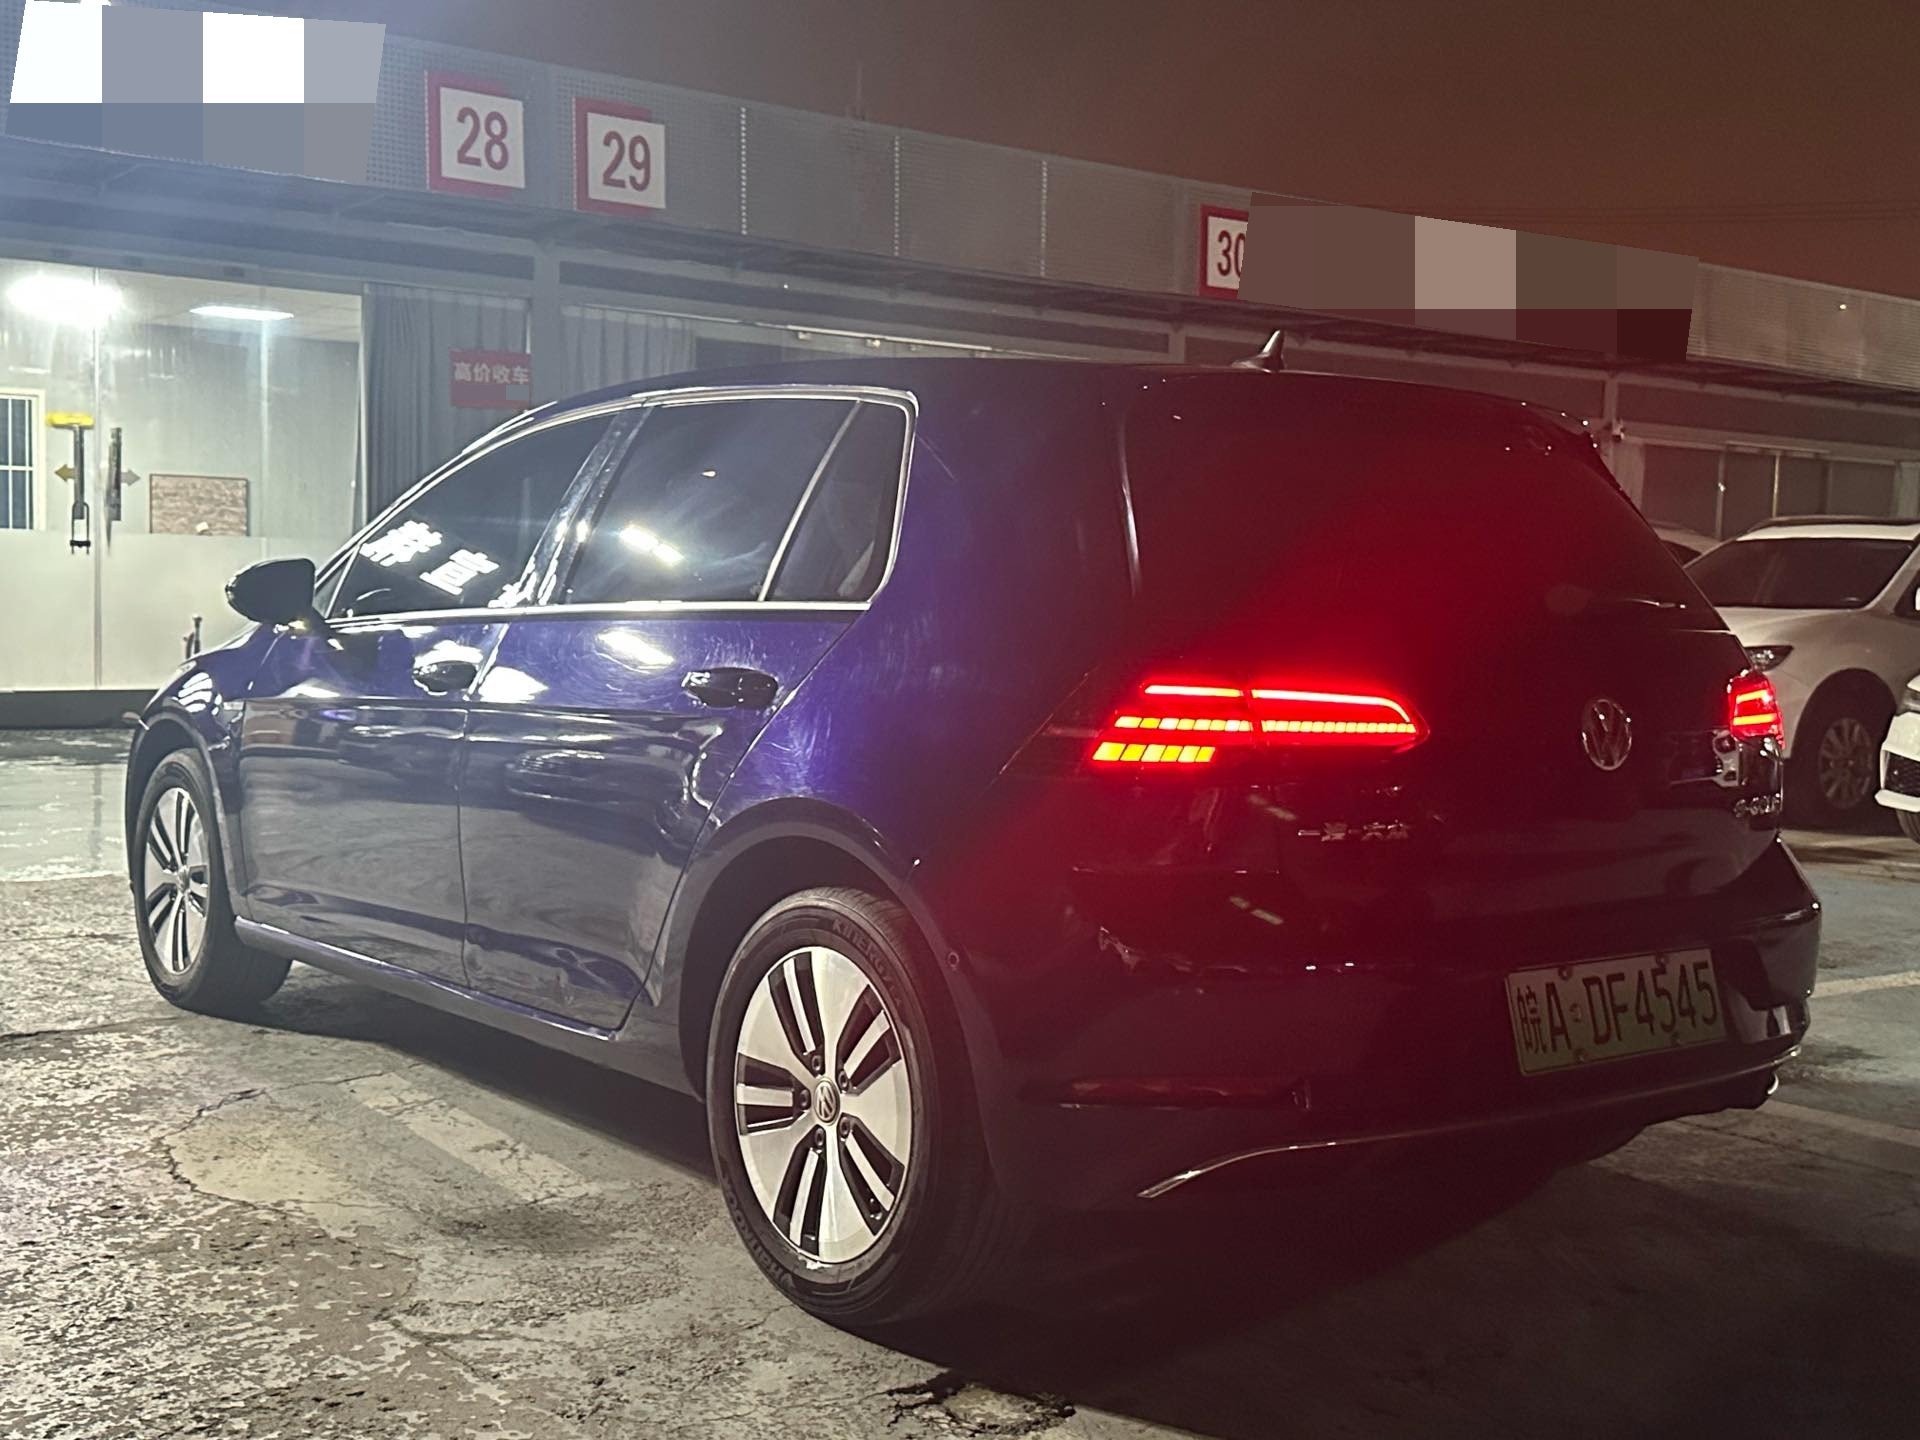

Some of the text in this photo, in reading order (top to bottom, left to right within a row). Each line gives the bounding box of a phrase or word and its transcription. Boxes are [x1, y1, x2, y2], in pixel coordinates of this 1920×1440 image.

[456, 107, 509, 171] 28
[602, 130, 652, 192] 29
[454, 361, 529, 385] 高价收车
